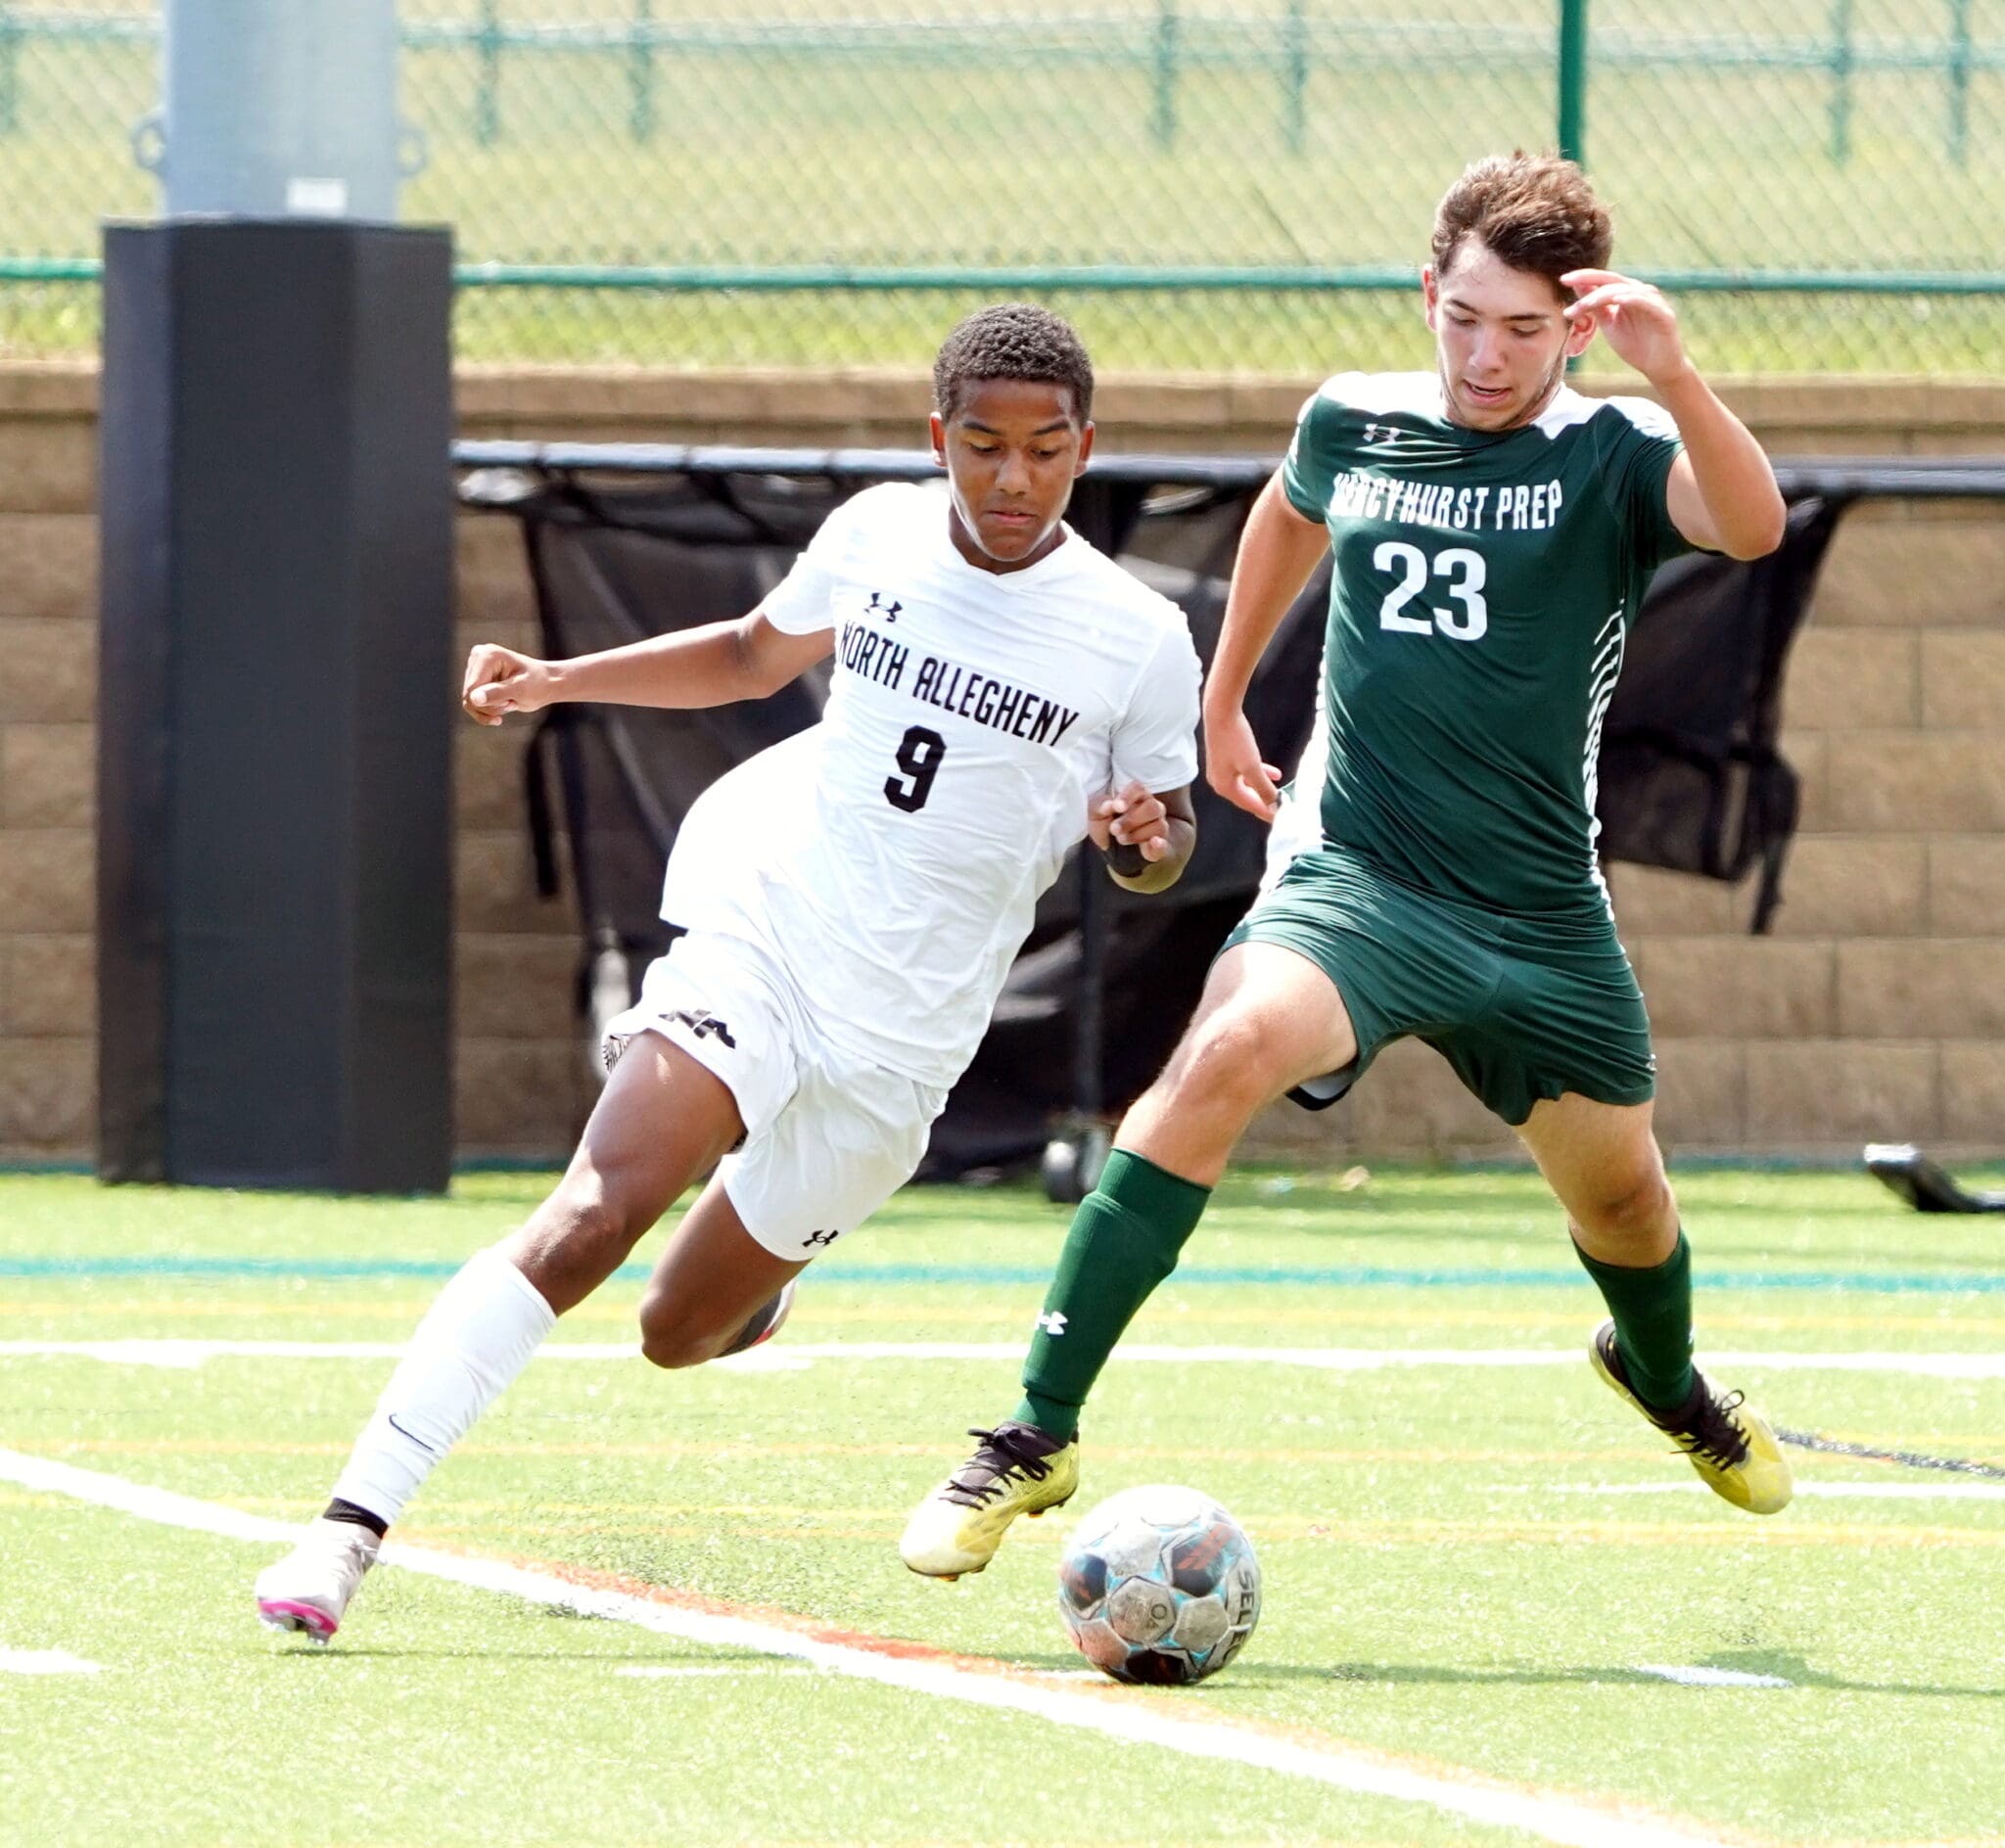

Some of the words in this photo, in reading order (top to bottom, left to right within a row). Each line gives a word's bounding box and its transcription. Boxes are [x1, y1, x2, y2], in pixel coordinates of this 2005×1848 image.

[1495, 479, 1563, 531] PREP
[1374, 541, 1488, 641] 23
[839, 619, 909, 690] NORTH
[911, 657, 1080, 747] ALLEGHENY
[883, 724, 947, 813] 9
